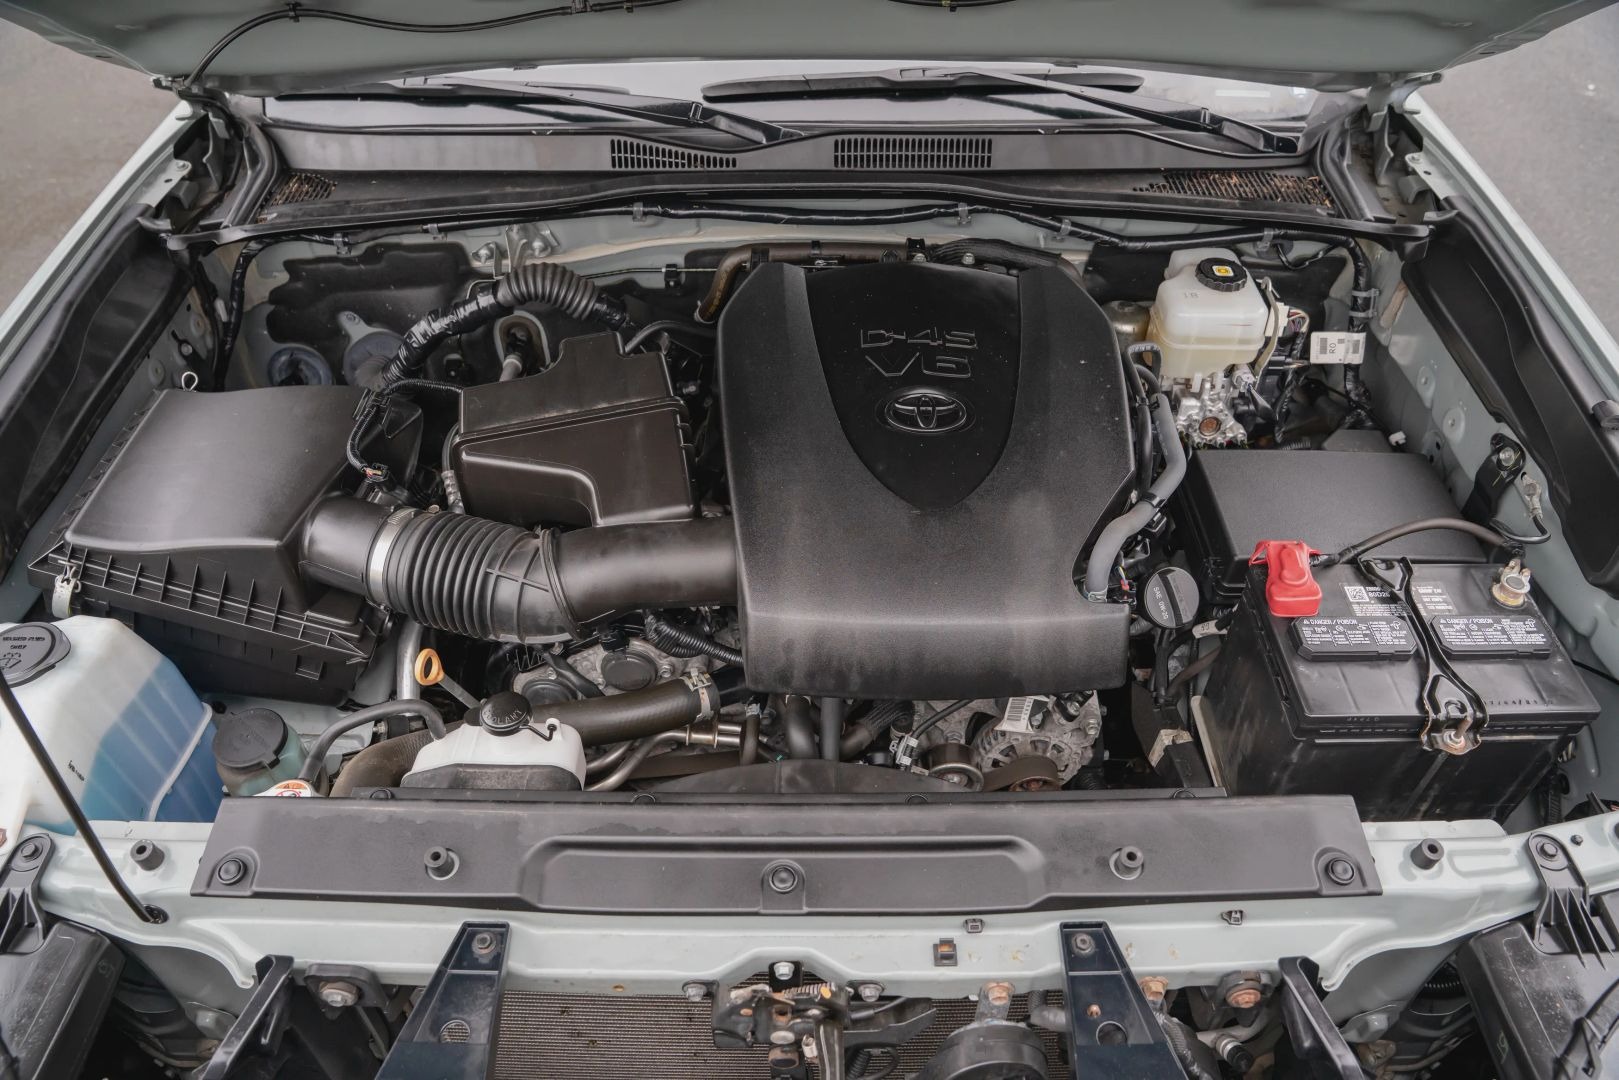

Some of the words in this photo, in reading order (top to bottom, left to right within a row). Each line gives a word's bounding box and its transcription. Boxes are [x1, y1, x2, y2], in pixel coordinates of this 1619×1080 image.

[860, 326, 978, 349] D-4S
[865, 352, 972, 378] V6
[1153, 586, 1162, 600] SAE
